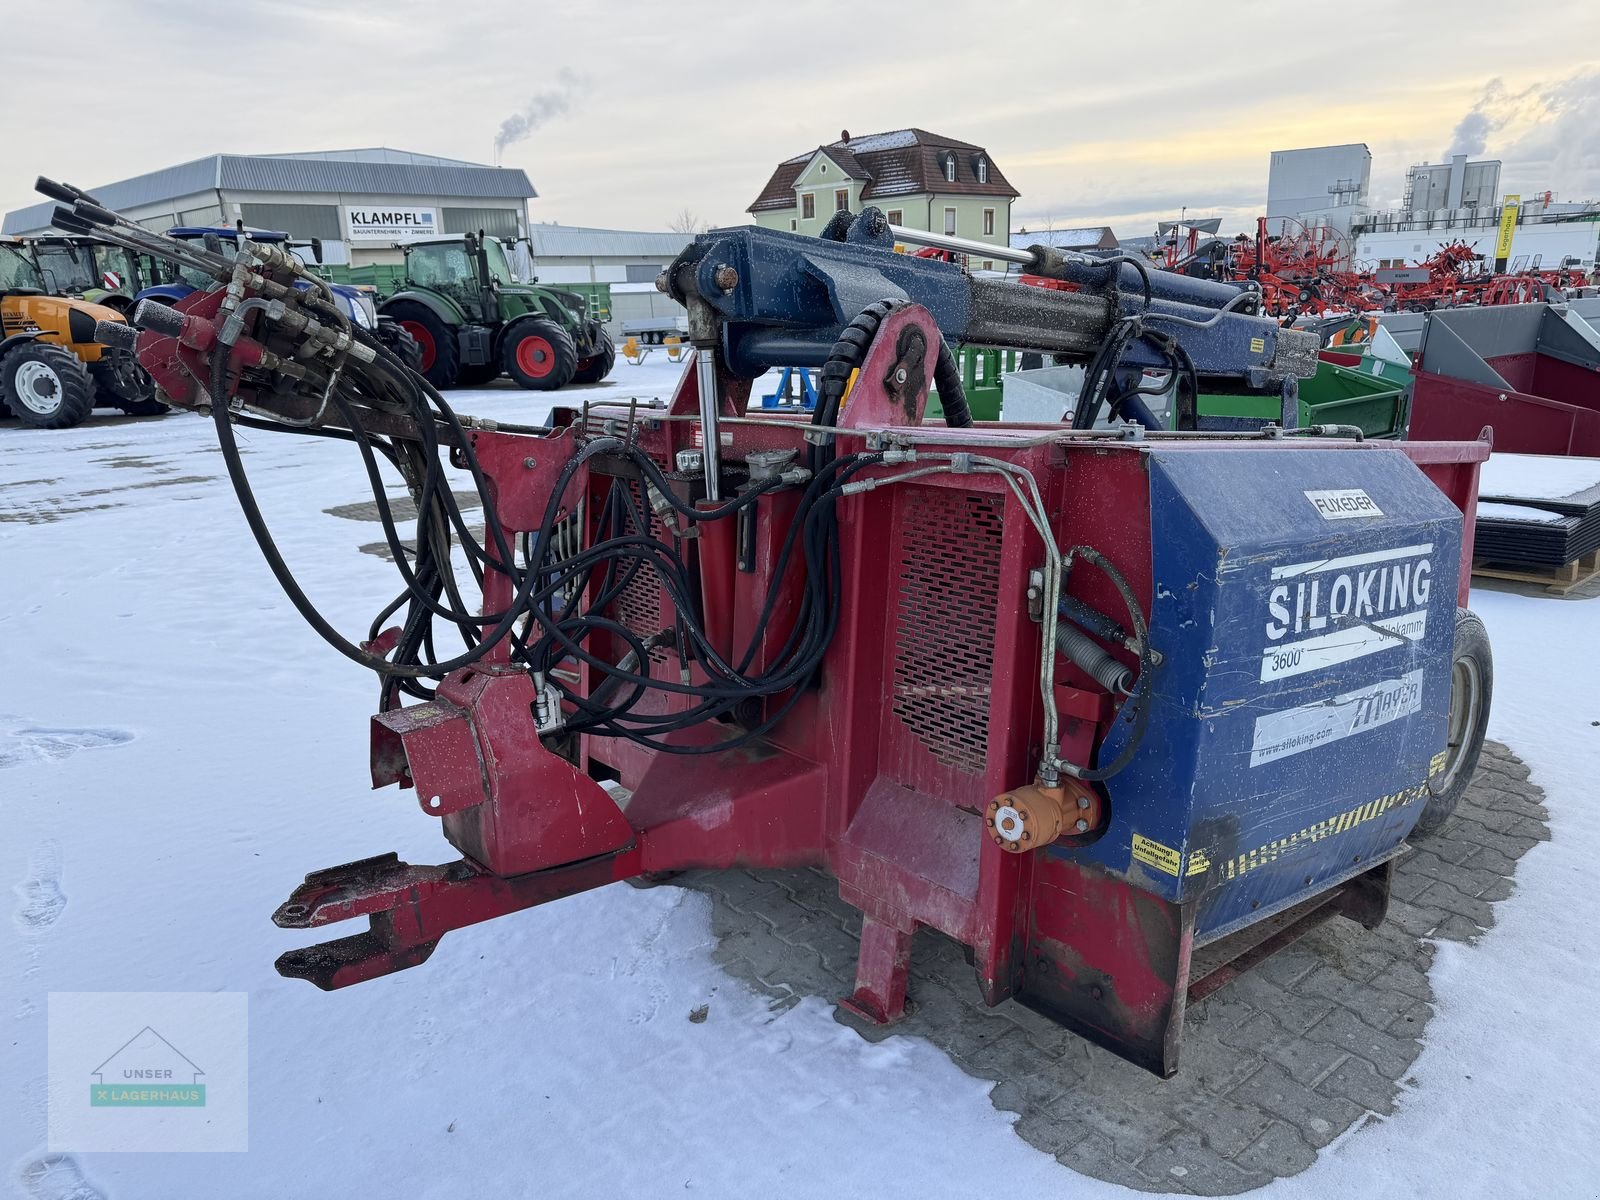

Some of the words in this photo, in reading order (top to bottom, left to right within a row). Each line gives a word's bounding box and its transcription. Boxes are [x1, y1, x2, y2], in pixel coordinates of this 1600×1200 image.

[351, 212, 421, 225] KLAMPFL
[1315, 496, 1375, 514] FLIXEDER
[1266, 559, 1431, 640] SILOKING
[1271, 651, 1301, 672] 3600
[1258, 728, 1333, 758] www.siloking.com
[1134, 843, 1178, 867] Unfallgefahr
[1141, 838, 1173, 857] Achtung!
